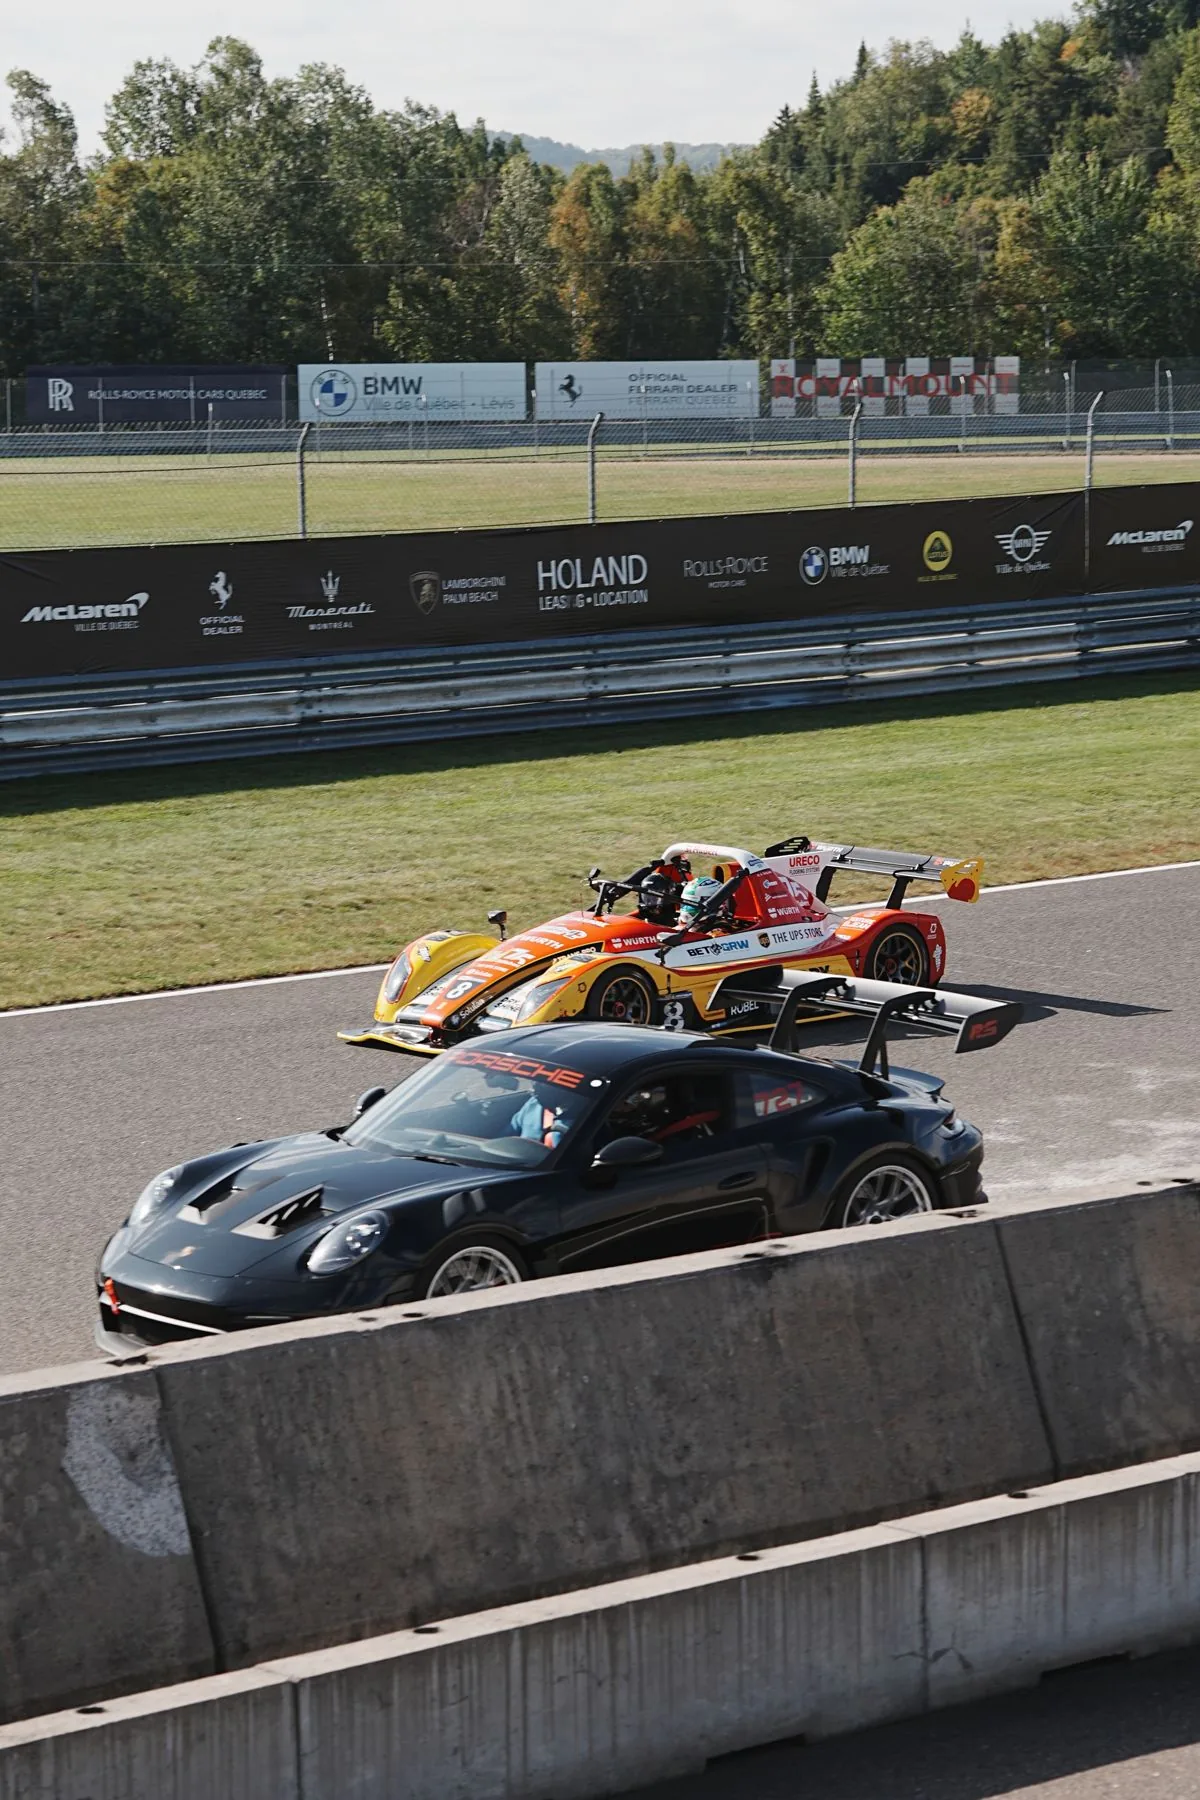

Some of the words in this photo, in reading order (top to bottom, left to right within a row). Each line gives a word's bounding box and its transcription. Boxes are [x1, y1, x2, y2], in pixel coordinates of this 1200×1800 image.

[363, 376, 423, 396] BMW
[628, 373, 688, 382] OFFICIAL
[773, 372, 1017, 399] ROYALMOUNT
[88, 390, 156, 400] ROLLS-ROYCE
[157, 390, 196, 400] MOTOR
[197, 390, 224, 400] CARS
[628, 385, 684, 394] FERRARI
[687, 384, 738, 393] DEALER
[1106, 525, 1190, 546] McLaren
[829, 545, 870, 566] BMW
[537, 554, 648, 591] HOLAND
[684, 556, 769, 577] ROLLS-ROYCE
[441, 576, 507, 590] LAMBORGHINI
[443, 593, 468, 604] PALM
[469, 591, 499, 603] BEACH
[539, 593, 585, 610] LEASG
[593, 589, 648, 607] LOCATION
[20, 598, 145, 622] McLaren
[285, 602, 376, 618] Maserati
[200, 615, 246, 625] OFFICIAL
[203, 625, 244, 636] DEALER
[789, 855, 820, 868] URECO
[772, 932, 788, 944] THE
[789, 930, 804, 941] UPS
[804, 928, 824, 938] STORE
[686, 947, 711, 957] BET
[722, 940, 750, 952] GRW
[446, 982, 473, 999] 8
[664, 1001, 685, 1032] 8
